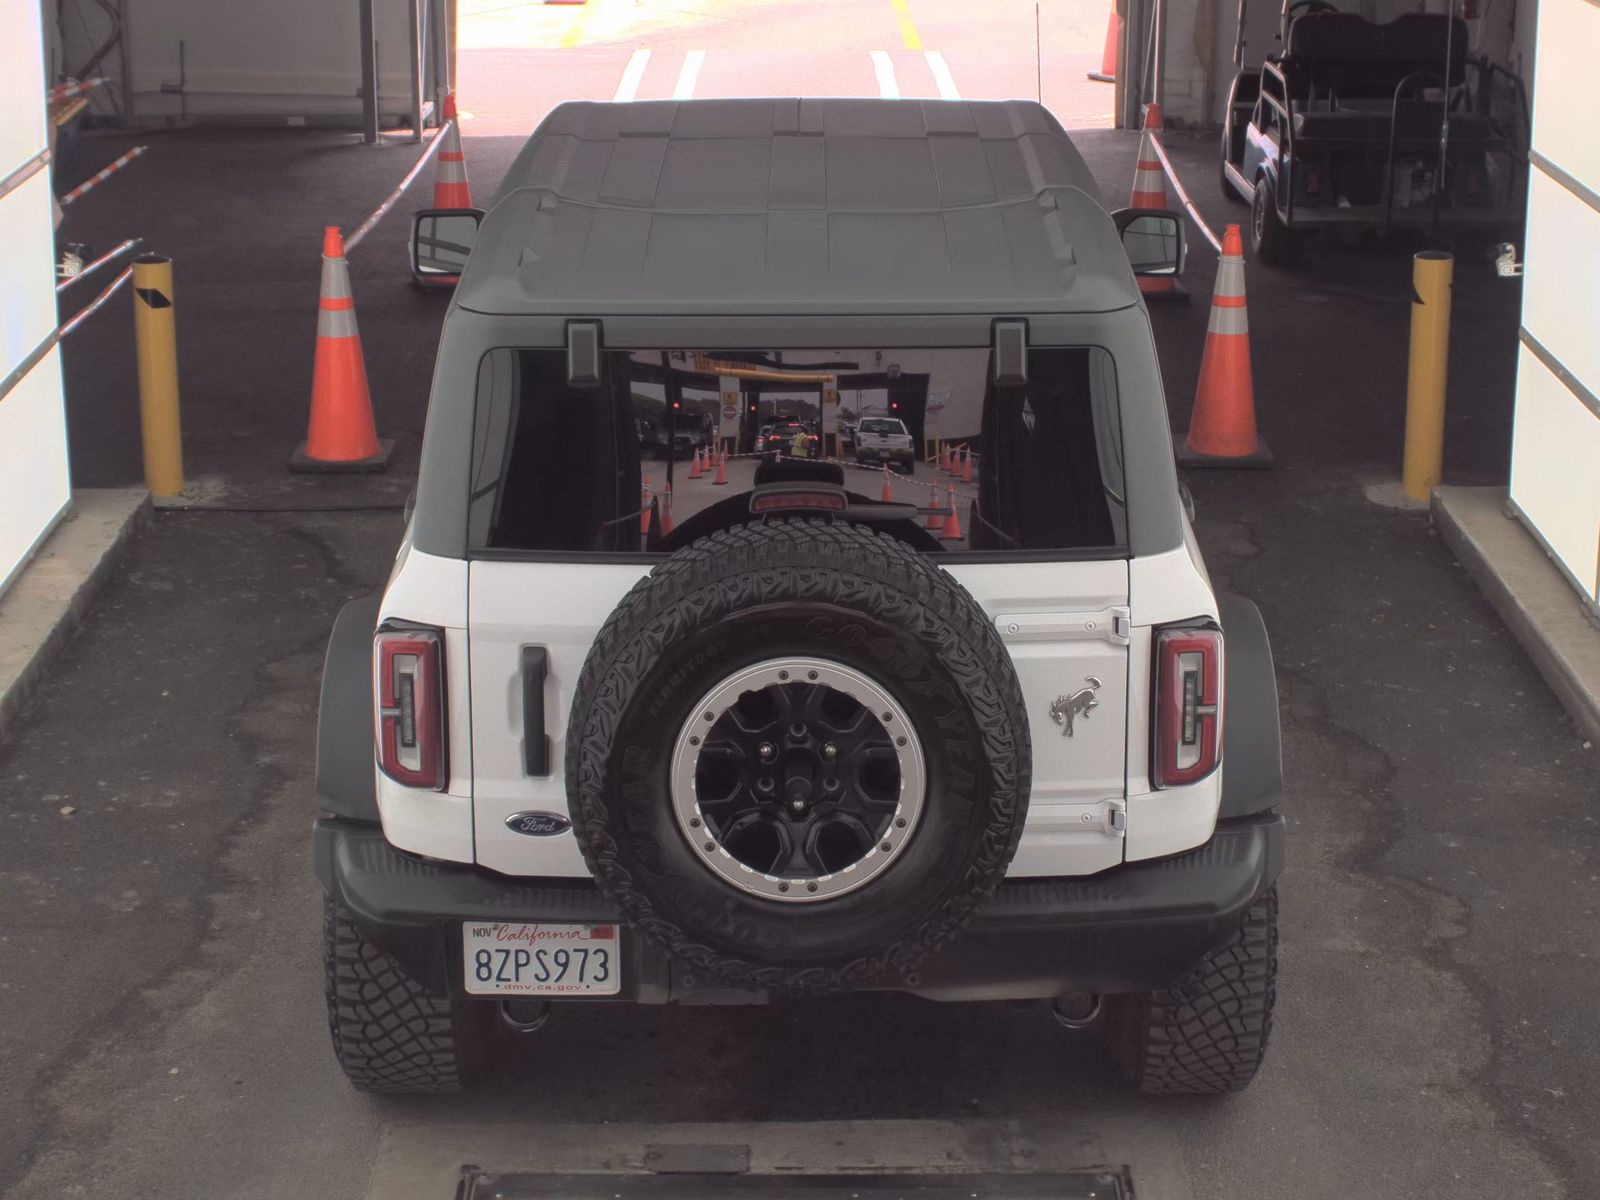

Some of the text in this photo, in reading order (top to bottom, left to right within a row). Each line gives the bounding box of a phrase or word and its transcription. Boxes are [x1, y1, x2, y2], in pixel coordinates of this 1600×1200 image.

[520, 816, 555, 831] Ford
[473, 928, 491, 937] NOV
[496, 924, 588, 946] California
[475, 948, 609, 983] 8ZPS973
[504, 984, 582, 992] dmv.ca.gov
